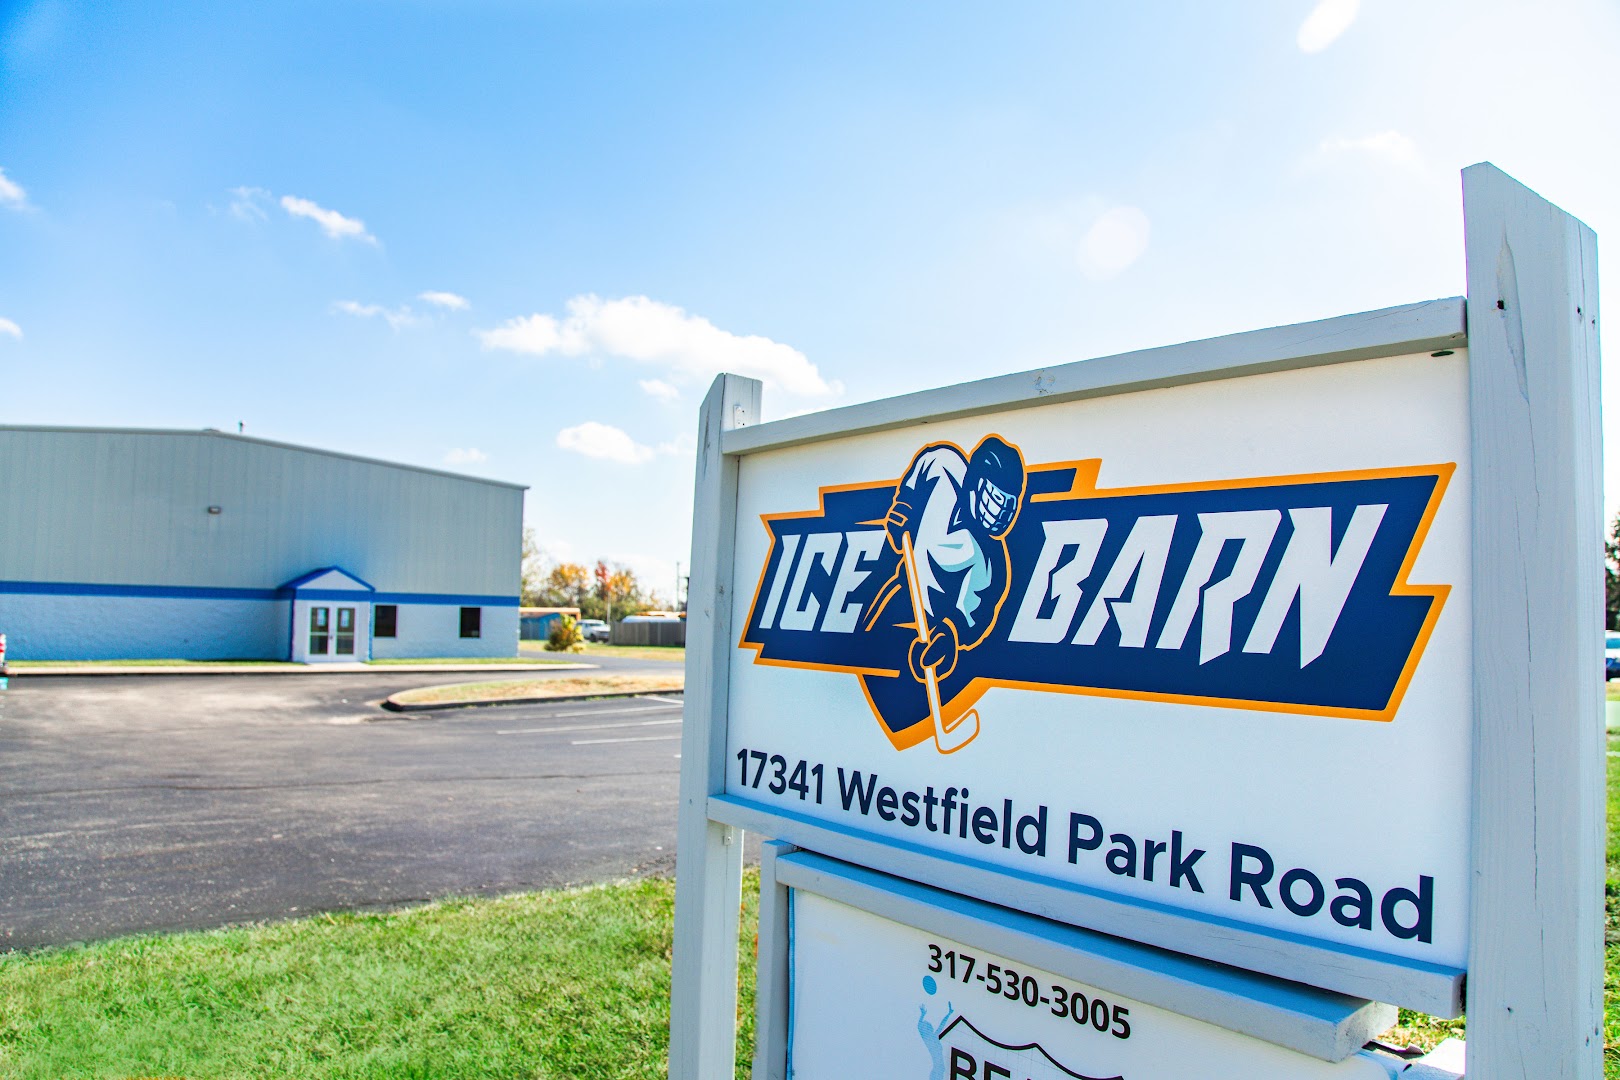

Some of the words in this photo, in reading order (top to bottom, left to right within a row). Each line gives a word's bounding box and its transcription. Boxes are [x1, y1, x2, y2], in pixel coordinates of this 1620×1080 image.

[759, 532, 886, 633] ICE
[1008, 503, 1389, 669] BARN
[737, 748, 825, 804] 17341
[837, 767, 1048, 857] Westfield
[1067, 811, 1207, 893] Park
[1230, 842, 1434, 944] Road
[928, 944, 1131, 1039] 317-530-3005
